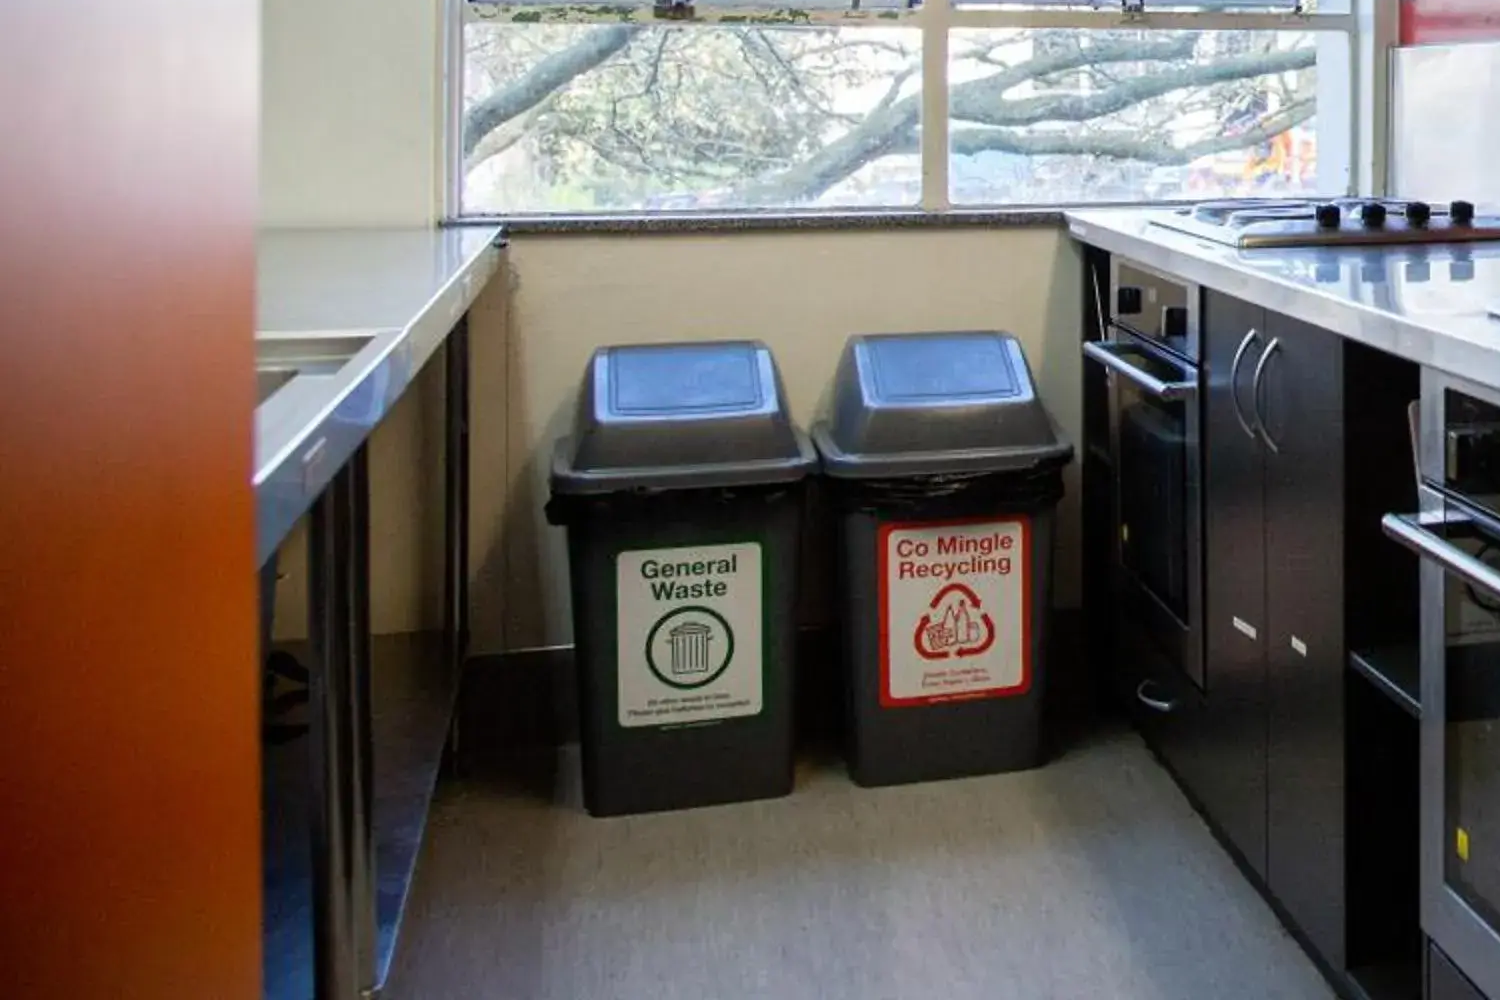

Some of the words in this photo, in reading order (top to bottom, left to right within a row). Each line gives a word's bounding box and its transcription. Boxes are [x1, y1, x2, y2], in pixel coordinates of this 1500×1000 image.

[896, 538, 929, 558] Co
[937, 532, 1014, 556] Mingle
[640, 553, 737, 580] General
[899, 555, 1012, 580] Recycling
[651, 578, 728, 601] Waste
